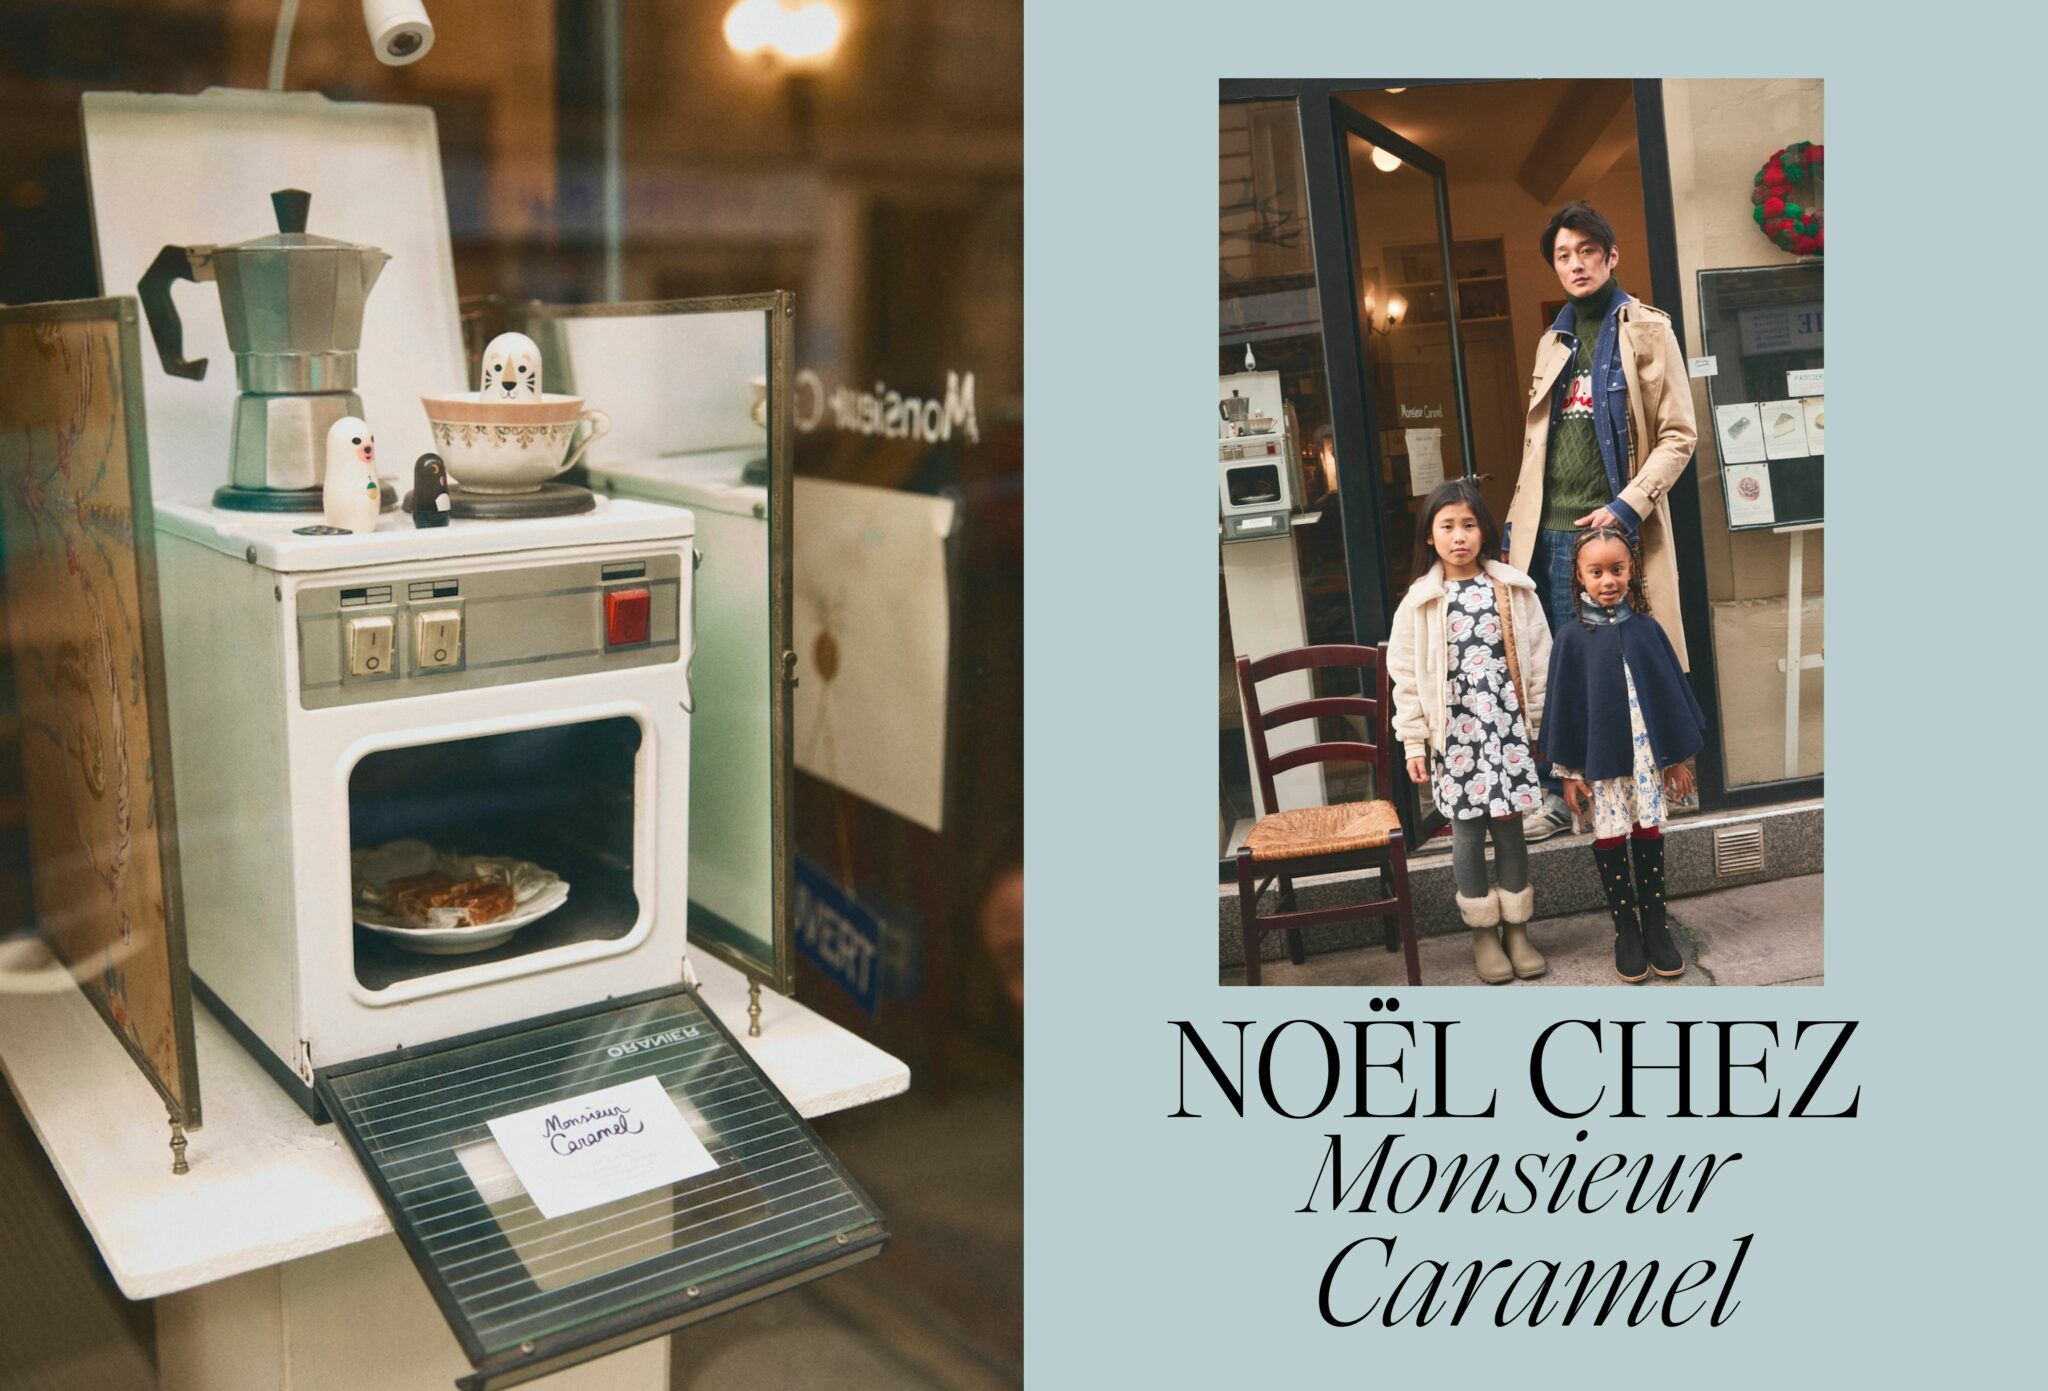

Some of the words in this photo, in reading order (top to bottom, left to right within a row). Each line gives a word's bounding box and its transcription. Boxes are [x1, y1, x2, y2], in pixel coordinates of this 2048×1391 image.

[795, 883, 876, 995] VERT
[542, 1106, 631, 1138] Monsieur
[551, 1115, 644, 1156] Caramel
